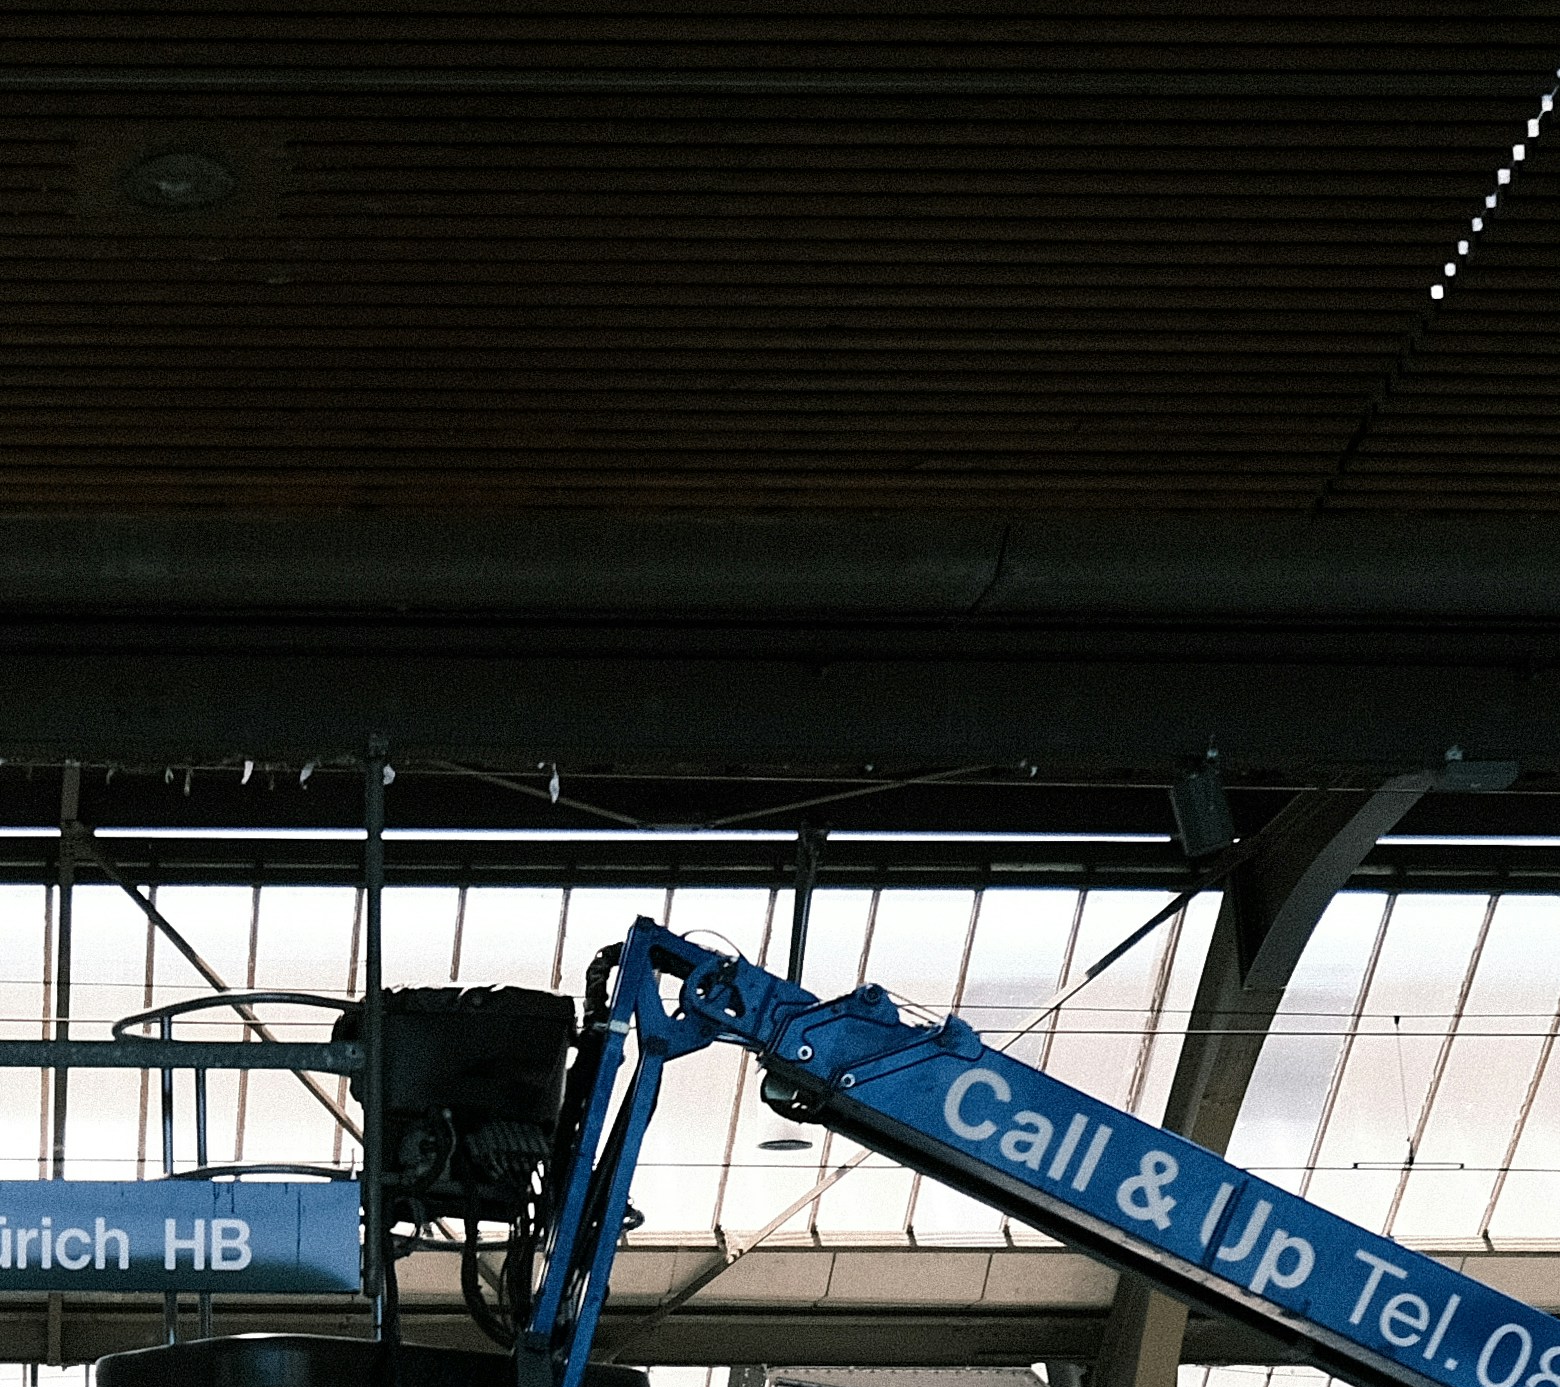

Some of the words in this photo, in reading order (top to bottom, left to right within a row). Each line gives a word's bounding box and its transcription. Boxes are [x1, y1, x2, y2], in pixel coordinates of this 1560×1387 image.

[164, 1217, 254, 1272] HB
[942, 1066, 1114, 1194] Call
[1116, 1149, 1179, 1231] &
[1199, 1181, 1316, 1296] Up
